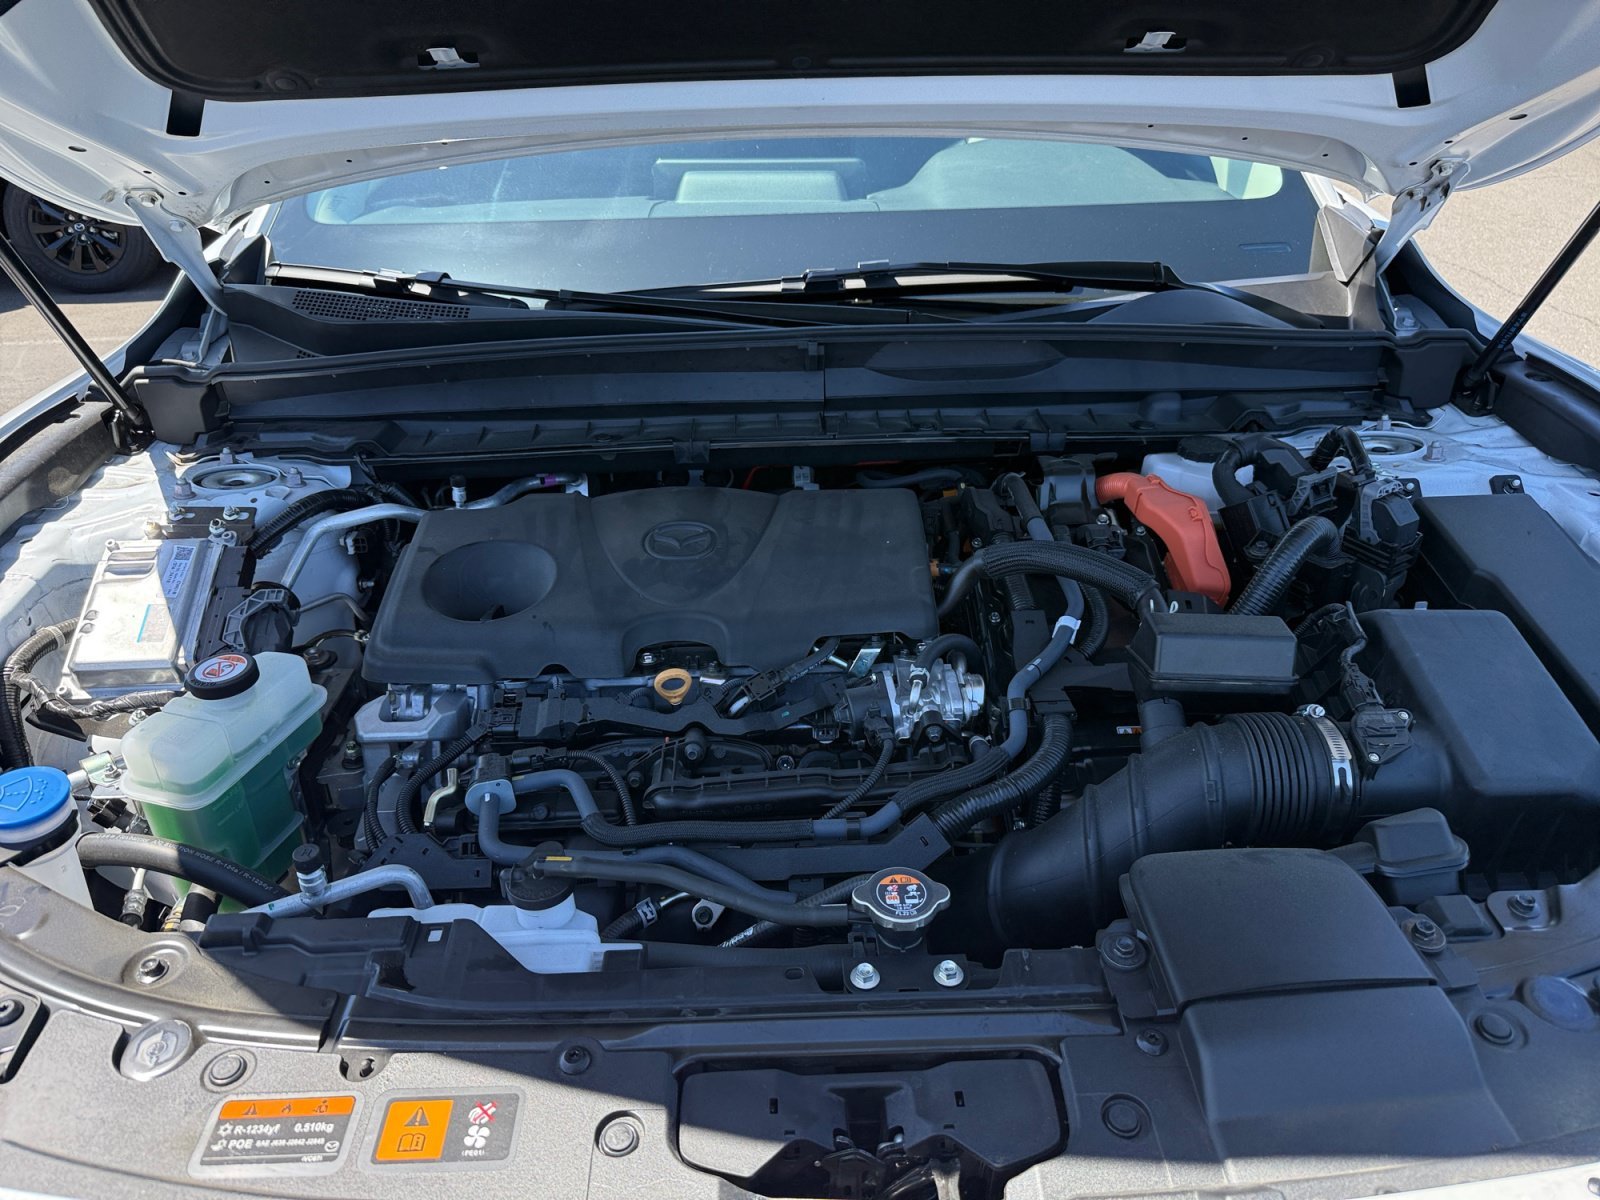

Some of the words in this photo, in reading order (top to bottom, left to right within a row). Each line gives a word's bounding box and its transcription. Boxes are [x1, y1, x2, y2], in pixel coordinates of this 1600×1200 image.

[194, 852, 216, 863] HOSE
[234, 1123, 280, 1135] R-1234yf
[294, 1122, 334, 1133] 0.510kg
[228, 1139, 253, 1149] POE
